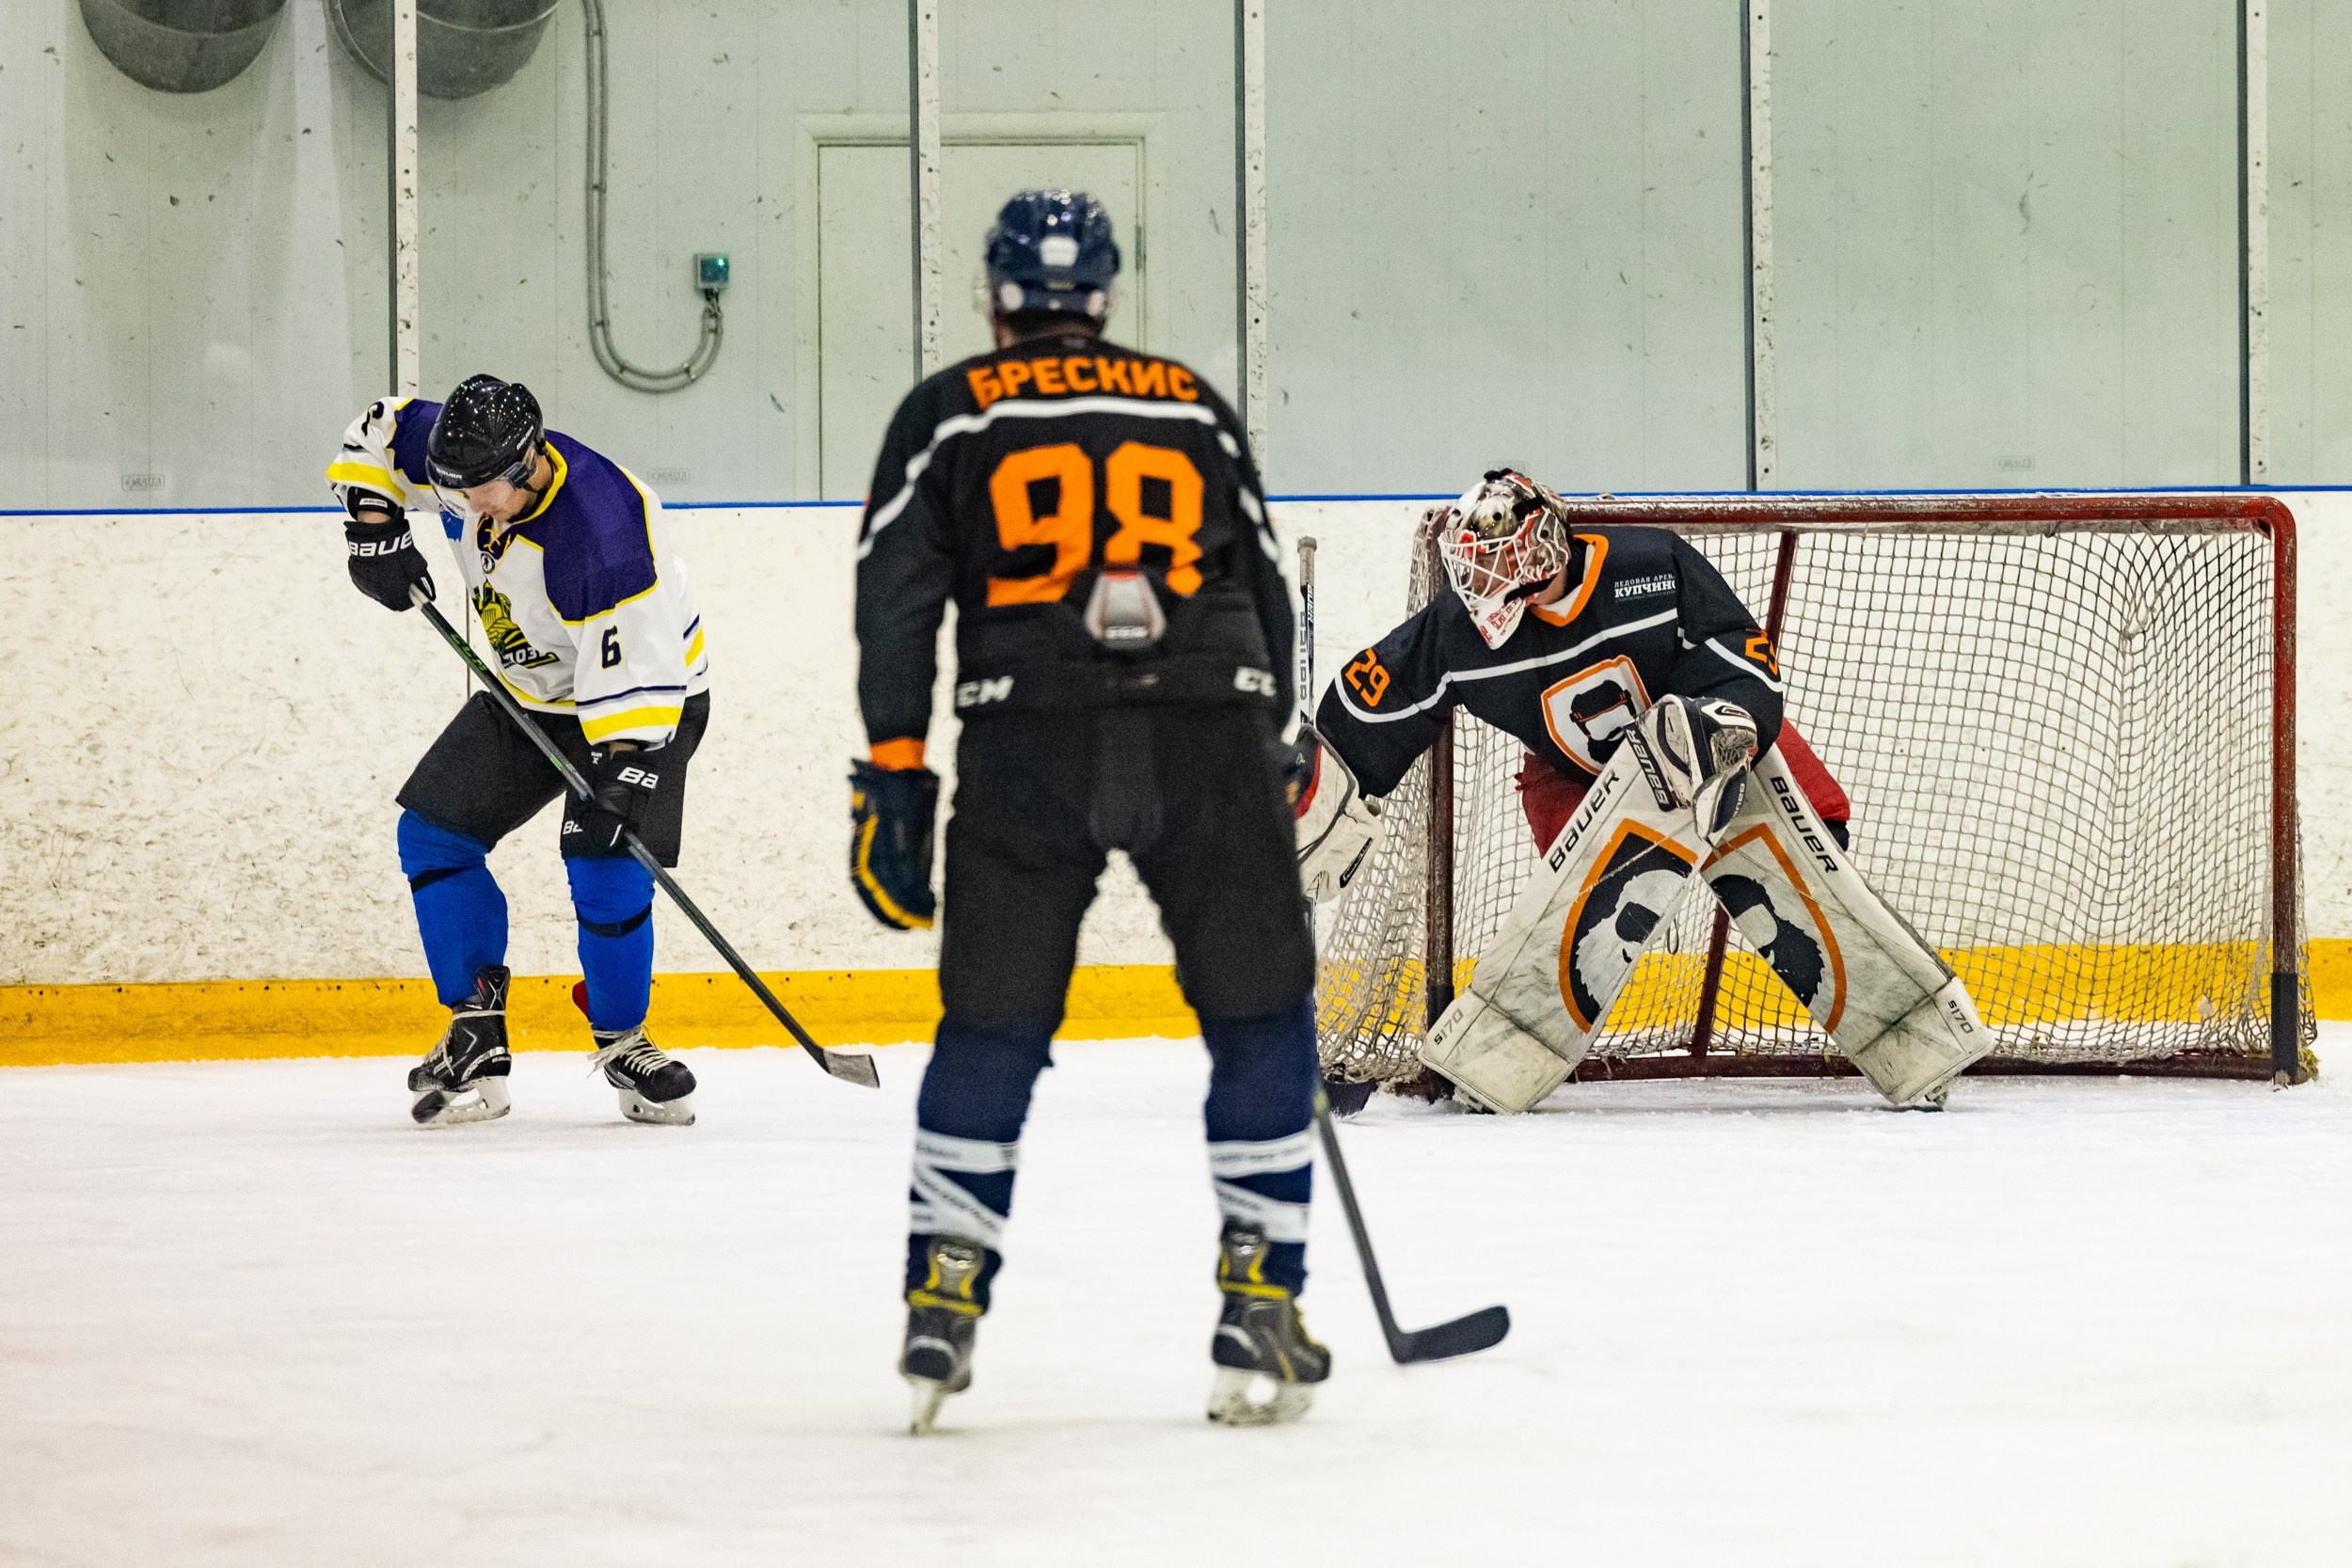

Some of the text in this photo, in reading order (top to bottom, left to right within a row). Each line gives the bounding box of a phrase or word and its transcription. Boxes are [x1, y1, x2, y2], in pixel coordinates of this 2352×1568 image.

[968, 356, 1200, 411] БРЕСКИС
[987, 442, 1204, 608] 98
[1614, 573, 1676, 589] ЛЕДОВАЯ АРЕН
[600, 625, 622, 670] 6
[1345, 647, 1391, 706] 29
[1626, 728, 1670, 805] BAUER
[1549, 768, 1620, 874] BAUER
[1770, 776, 1838, 873] BAUER
[1434, 1007, 1464, 1045] S170
[1947, 999, 1974, 1034] S170
